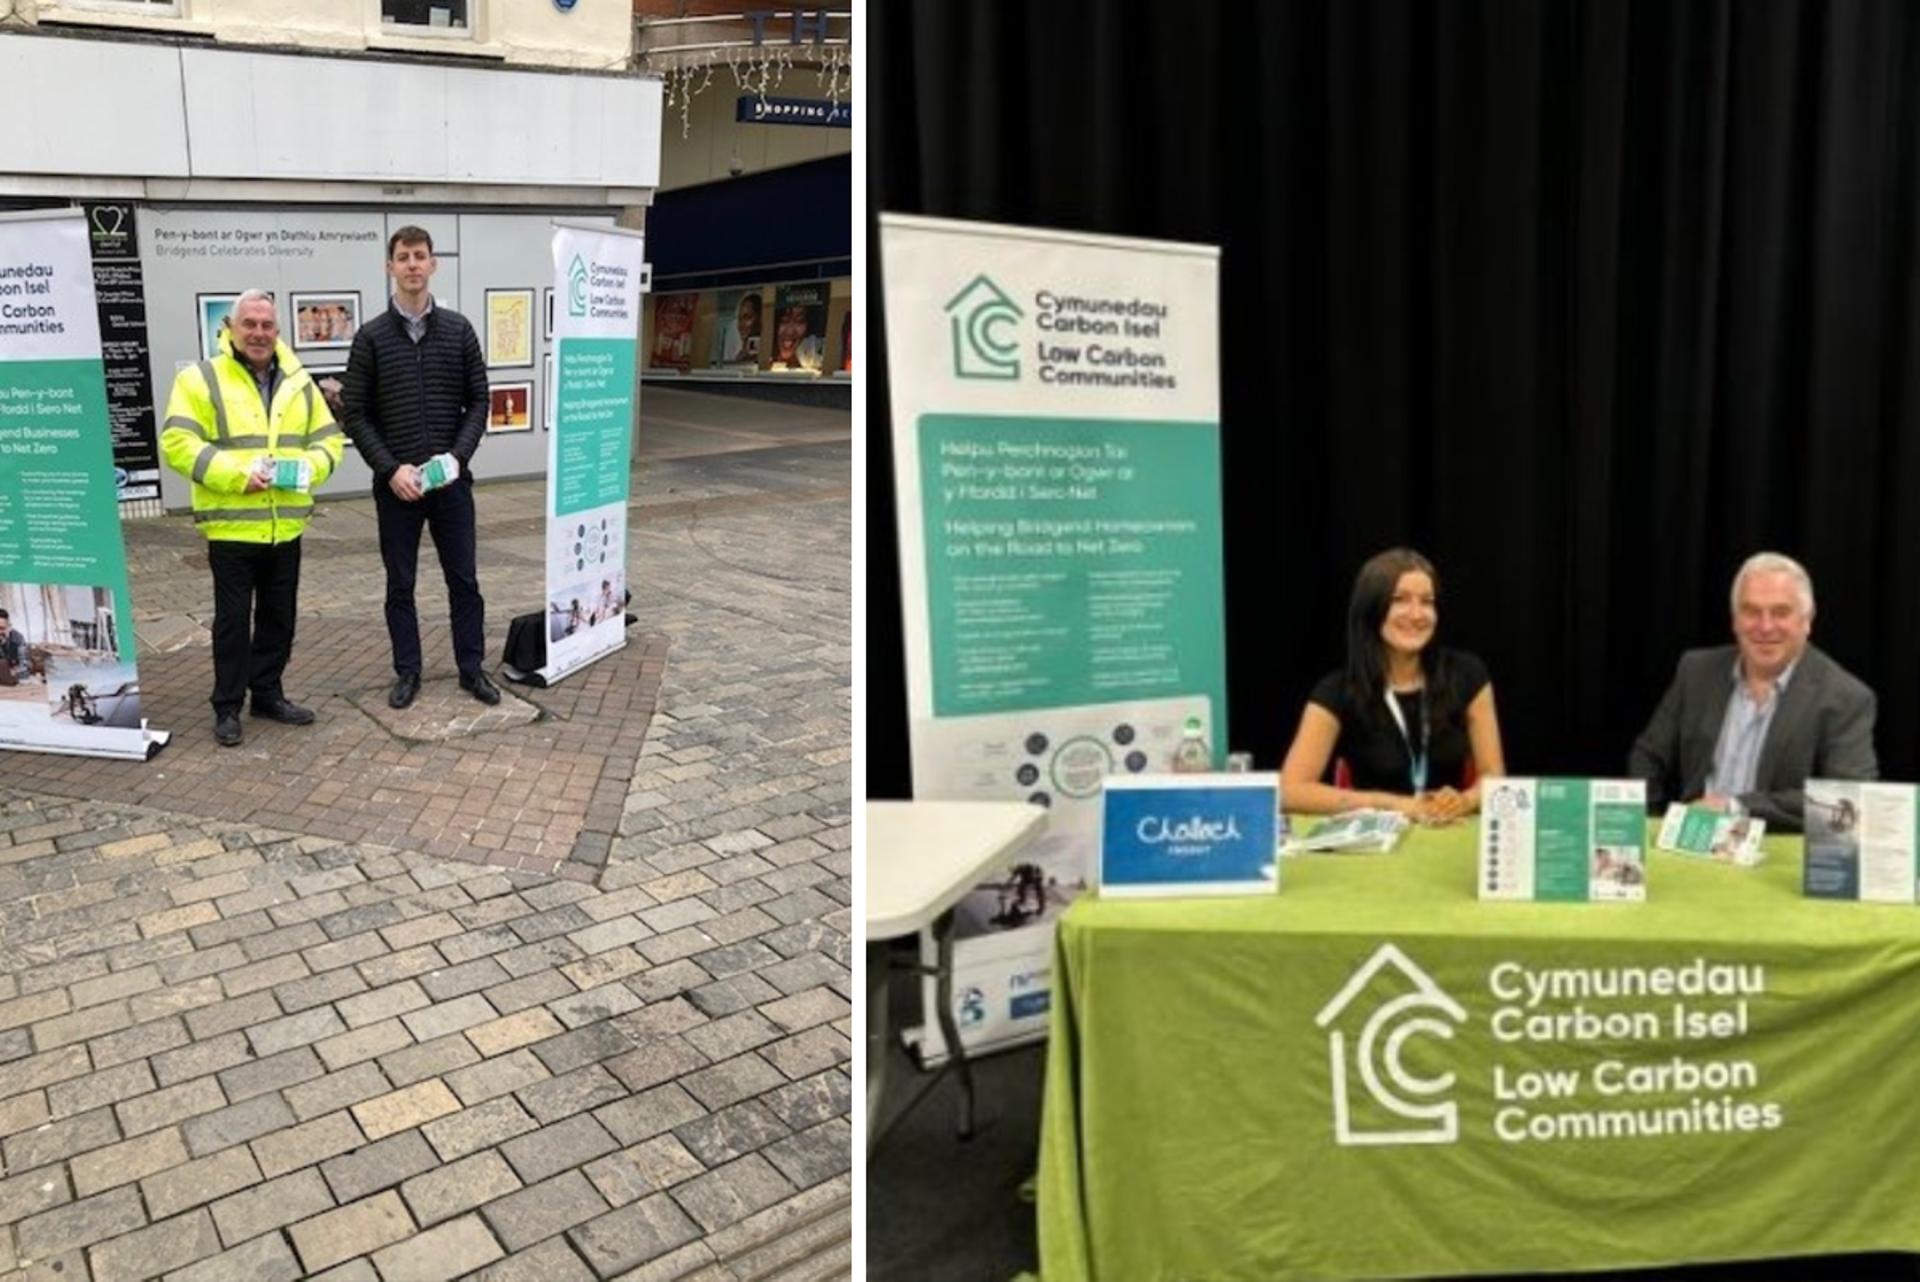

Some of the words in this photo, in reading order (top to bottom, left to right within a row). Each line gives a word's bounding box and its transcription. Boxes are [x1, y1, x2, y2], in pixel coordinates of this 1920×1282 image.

[755, 103, 825, 117] SHOPPING
[154, 228, 218, 242] Pen-y-bont
[220, 230, 233, 241] ar
[235, 229, 264, 243] Ogwr
[266, 231, 279, 243] yn
[281, 230, 316, 241] Dathlu
[318, 231, 379, 243] Amrywiaeth
[156, 245, 207, 258] Bridgend
[209, 245, 266, 257] Celebrates
[269, 245, 314, 258] Diversity
[25, 279, 50, 294] Isel
[2, 303, 56, 318] Carbon
[1035, 290, 1167, 318] Cymunedau
[1036, 314, 1119, 335] Carbon
[1124, 320, 1160, 338] Isel
[1038, 342, 1081, 362] Low
[1086, 344, 1165, 368] Carbon
[1039, 366, 1176, 389] Communities
[11, 387, 74, 400] Pen-y-bont
[37, 403, 61, 415] Sero
[63, 403, 83, 415] Net
[24, 427, 80, 439] Businesses
[13, 442, 32, 454] Net
[33, 442, 59, 455] Zero
[941, 463, 1045, 482] Pen-y-bont
[1489, 959, 1765, 1007] Cymunedau
[1491, 1005, 1660, 1042] Carbon
[1673, 1001, 1749, 1040] Isel
[1493, 1064, 1580, 1101] Low
[1592, 1057, 1757, 1095] Carbon
[1493, 1096, 1783, 1143] Communities
